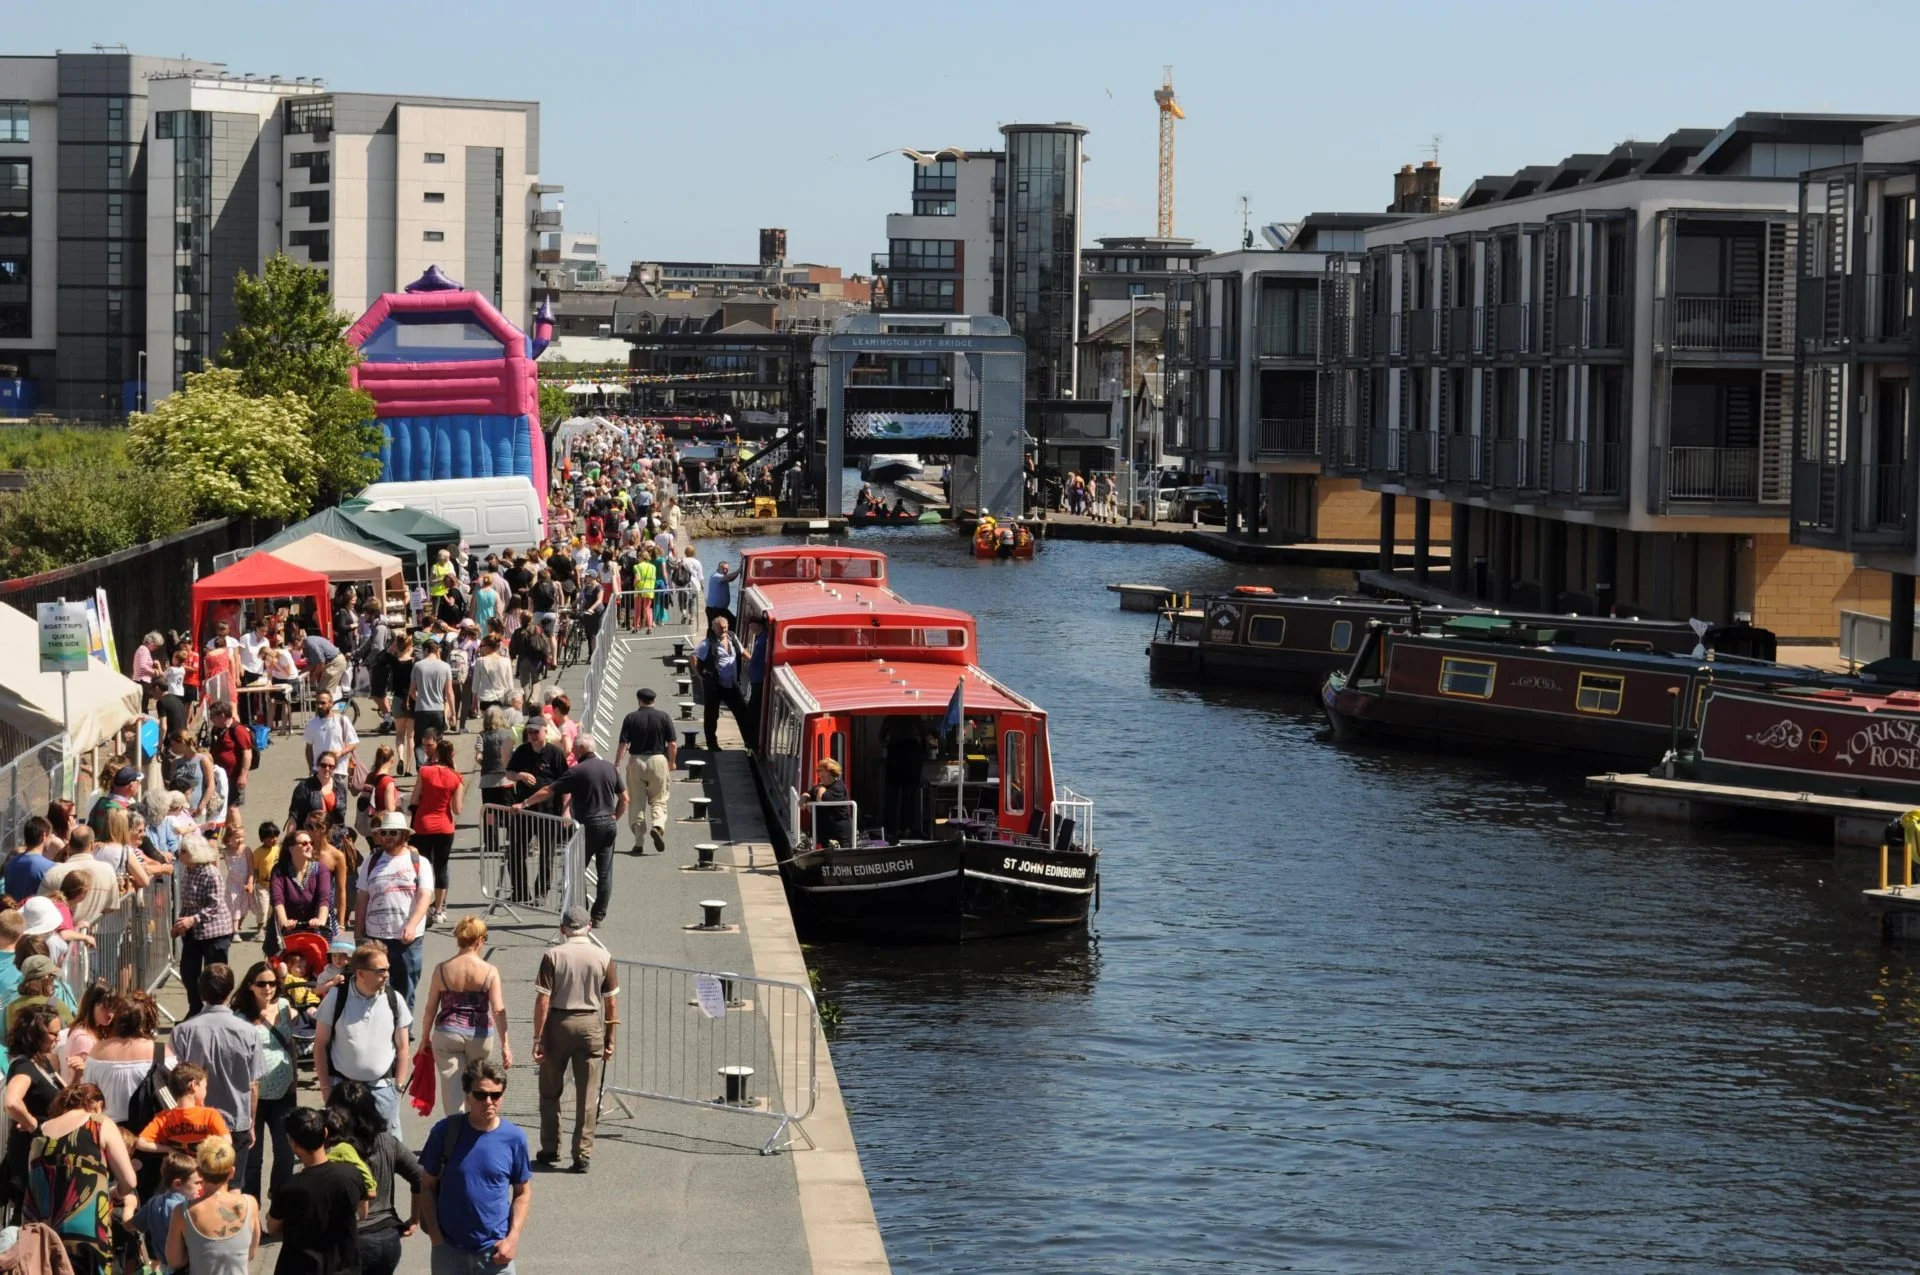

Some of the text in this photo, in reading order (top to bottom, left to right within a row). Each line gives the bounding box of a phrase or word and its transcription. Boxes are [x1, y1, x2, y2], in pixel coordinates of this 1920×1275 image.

[852, 338, 973, 347] LEAMINGTON LIFT BRIDGE
[1868, 746, 1920, 770] ROSE
[821, 859, 914, 877] ST JOHN EDINBURGH
[1003, 857, 1086, 879] ST JOHN EDINBURGH
